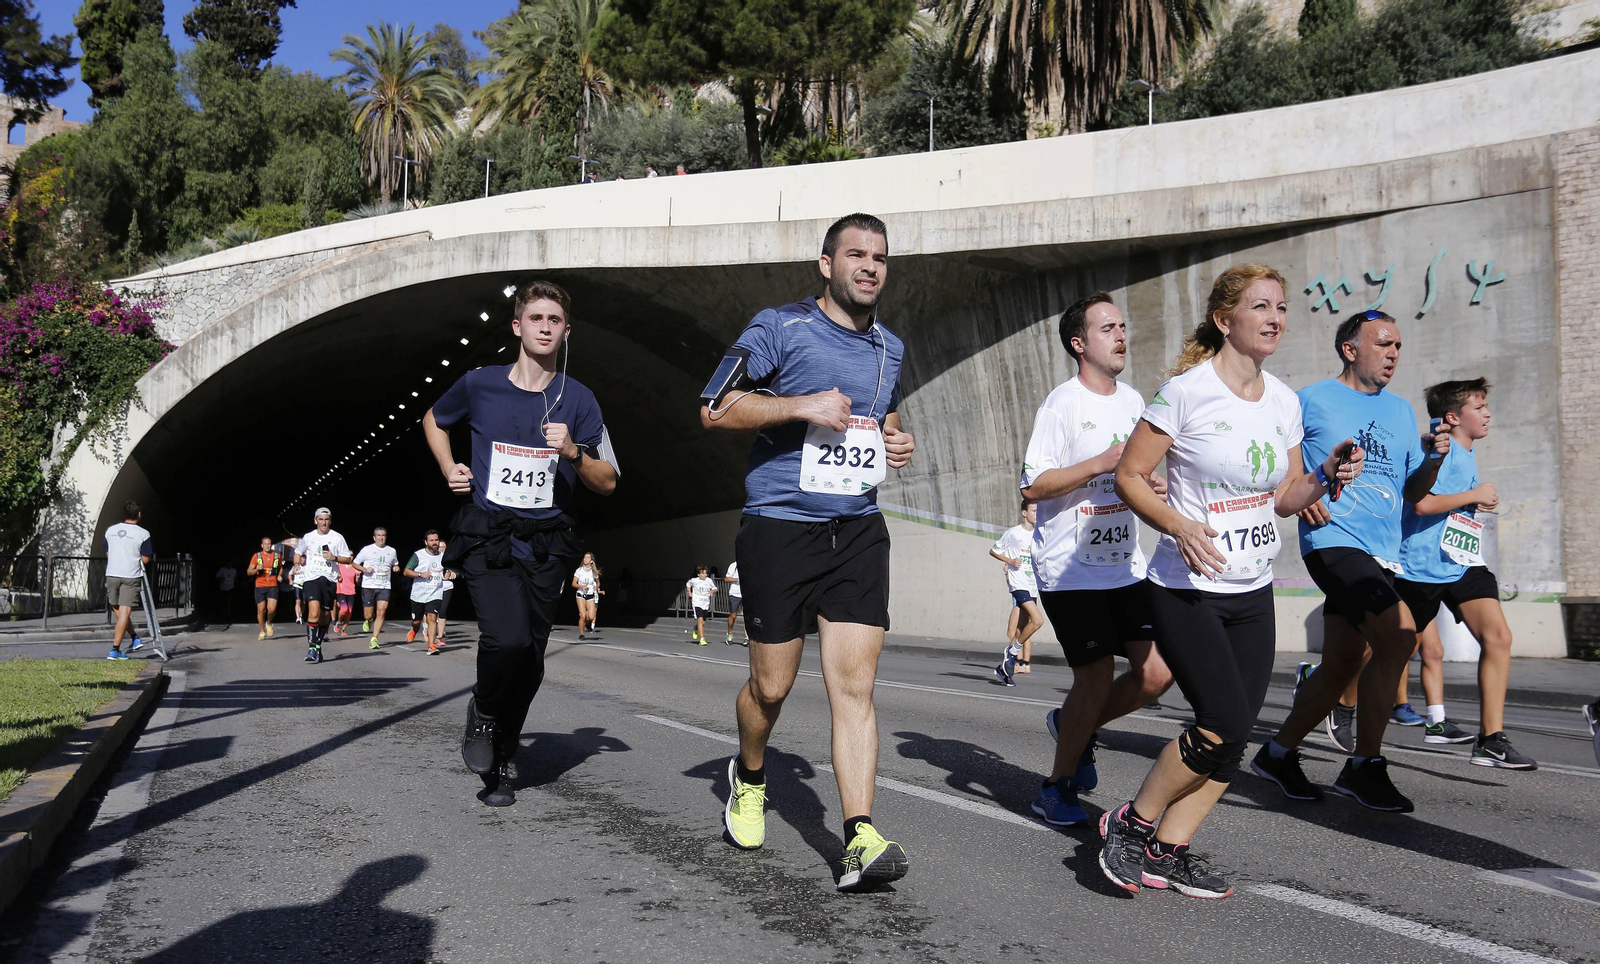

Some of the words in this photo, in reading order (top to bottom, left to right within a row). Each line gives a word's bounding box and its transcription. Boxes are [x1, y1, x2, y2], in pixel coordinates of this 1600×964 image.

[495, 444, 505, 454] 41
[507, 446, 534, 454] CARRERA
[818, 444, 876, 468] 2932
[501, 468, 546, 487] 2413
[1079, 506, 1094, 516] 41
[1207, 501, 1226, 514] 41
[1225, 495, 1260, 507] CARRERA
[1227, 504, 1250, 513] CIUDAD
[1089, 524, 1130, 546] 2434
[1220, 521, 1276, 552] 17699
[1443, 530, 1479, 554] 20113
